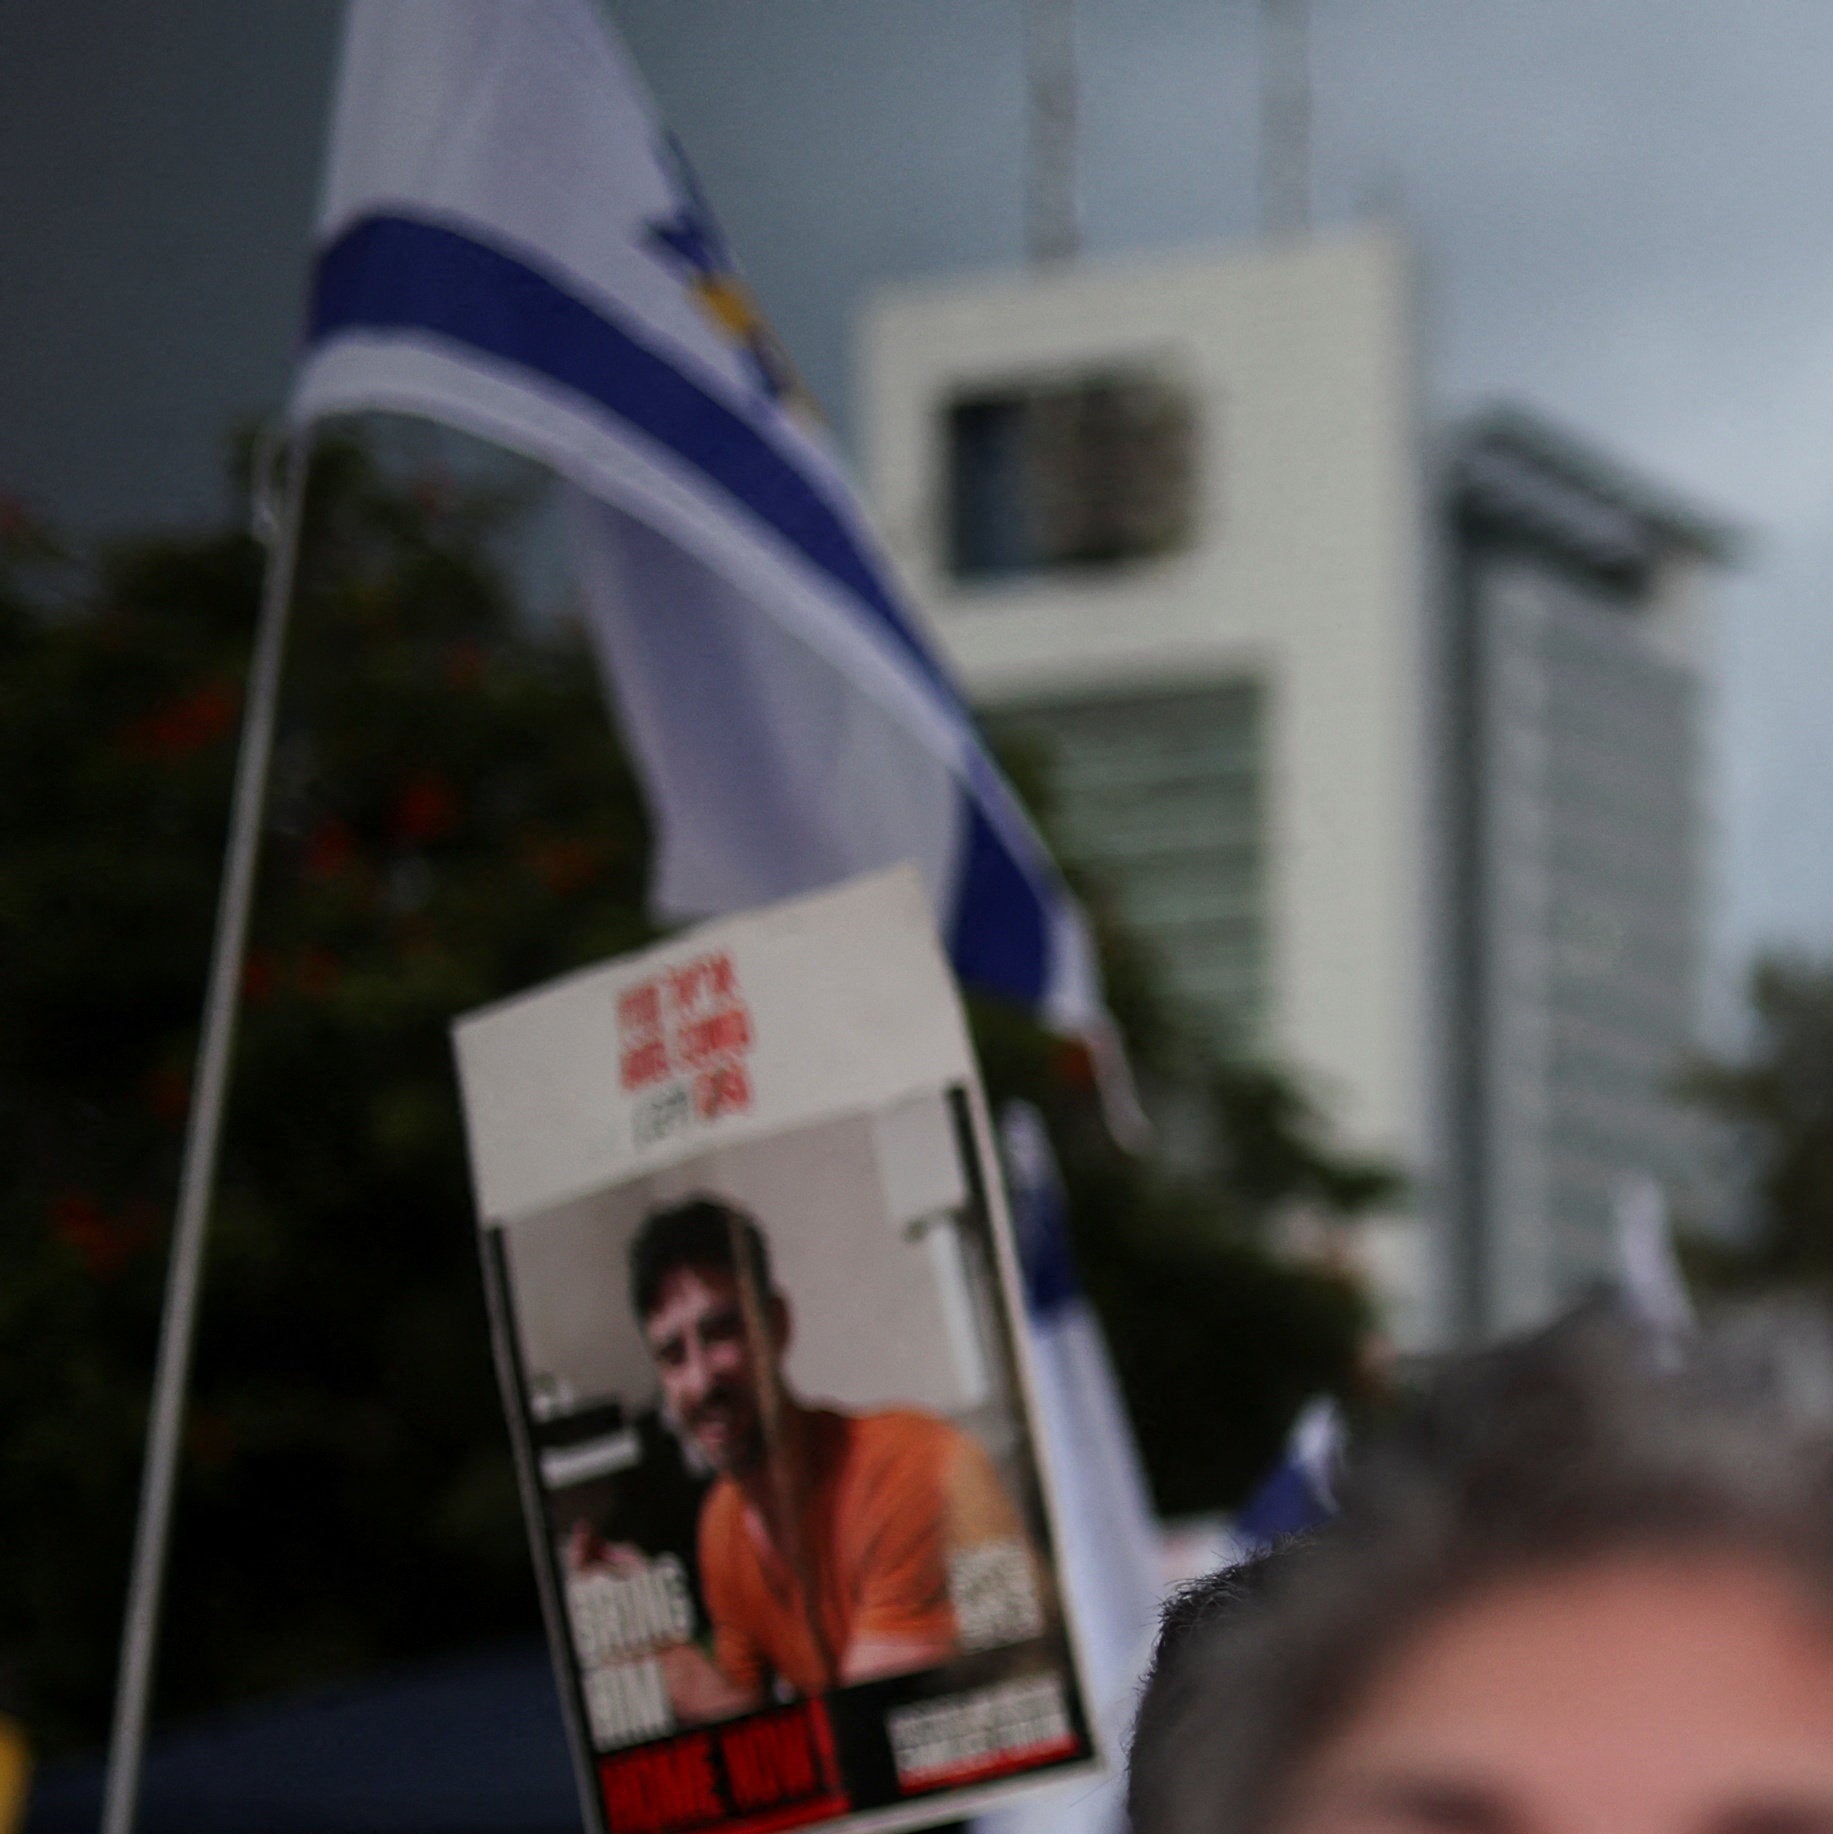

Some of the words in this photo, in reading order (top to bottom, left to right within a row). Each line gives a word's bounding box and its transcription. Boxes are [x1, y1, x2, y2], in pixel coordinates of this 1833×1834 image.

[566, 1552, 695, 1667] BRING
[582, 1653, 678, 1752] HIM
[720, 1699, 841, 1810] NOW!
